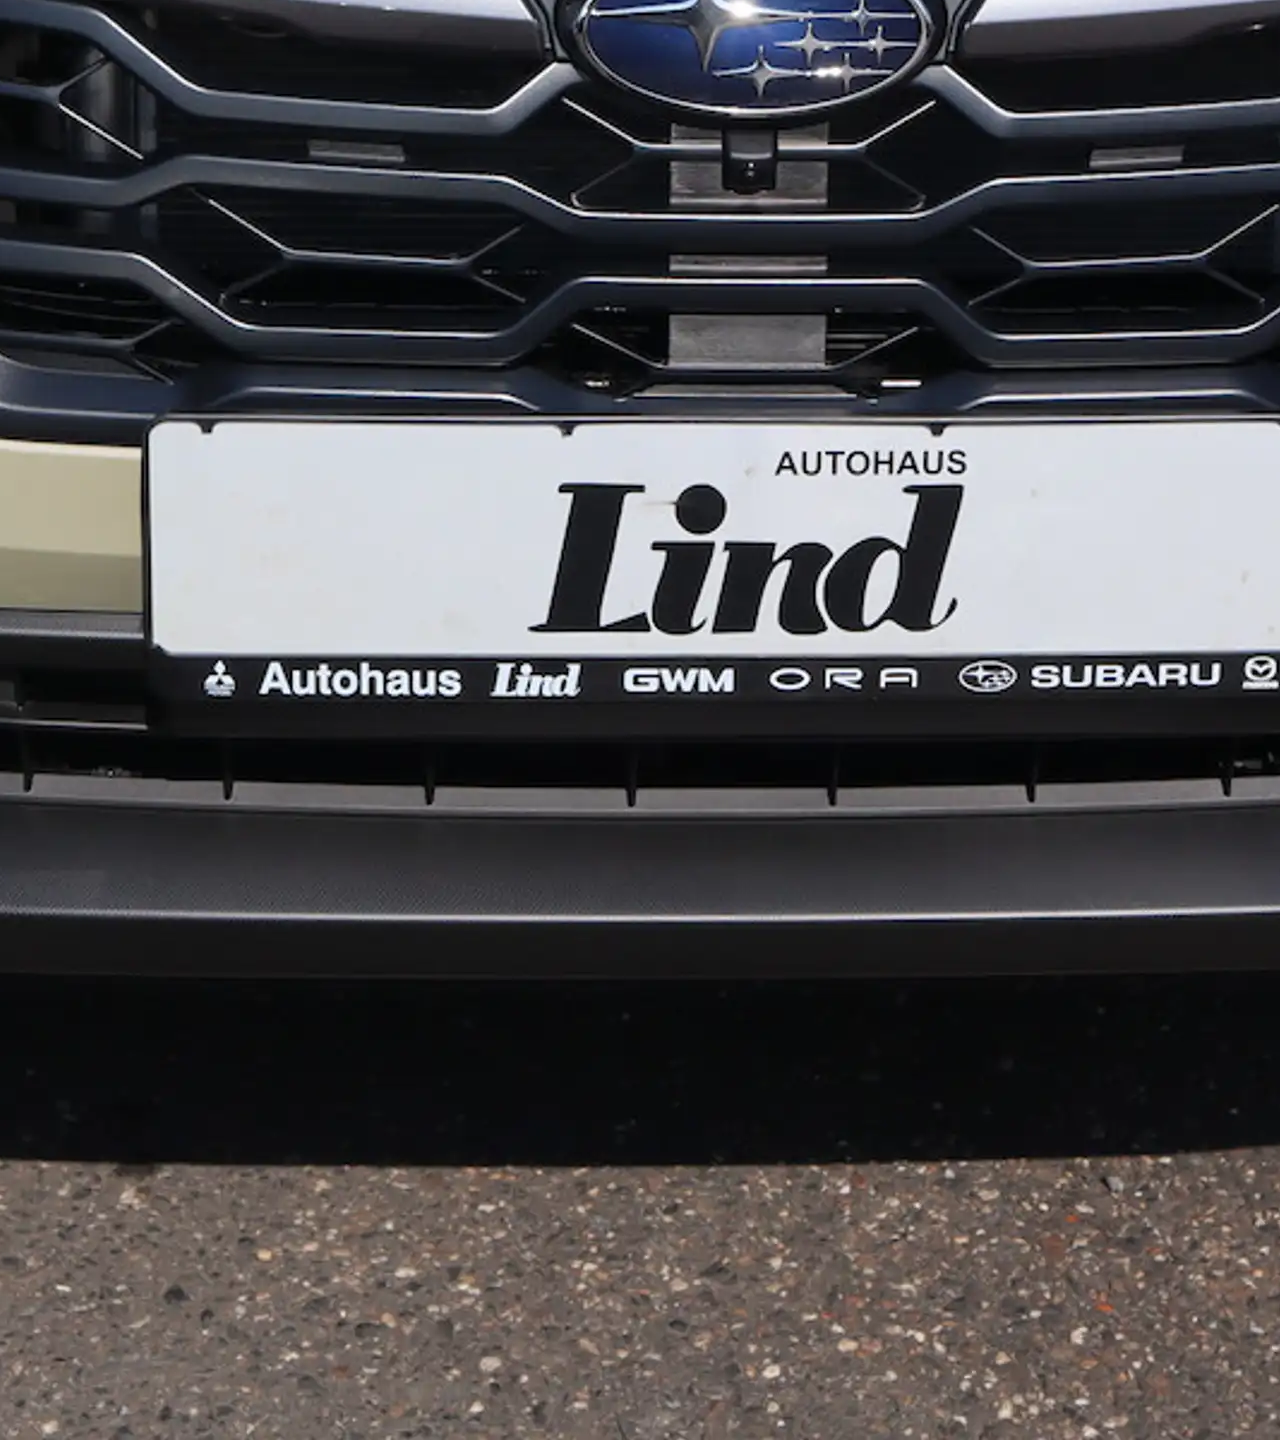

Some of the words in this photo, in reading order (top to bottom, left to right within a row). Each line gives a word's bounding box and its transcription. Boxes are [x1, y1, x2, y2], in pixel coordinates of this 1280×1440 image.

[775, 450, 968, 477] AUTOHAUS
[527, 482, 965, 636] Lind
[258, 661, 462, 697] Autohaus
[490, 662, 581, 697] Lind
[623, 666, 735, 693] GWM
[1031, 662, 1221, 689] SUBARU
